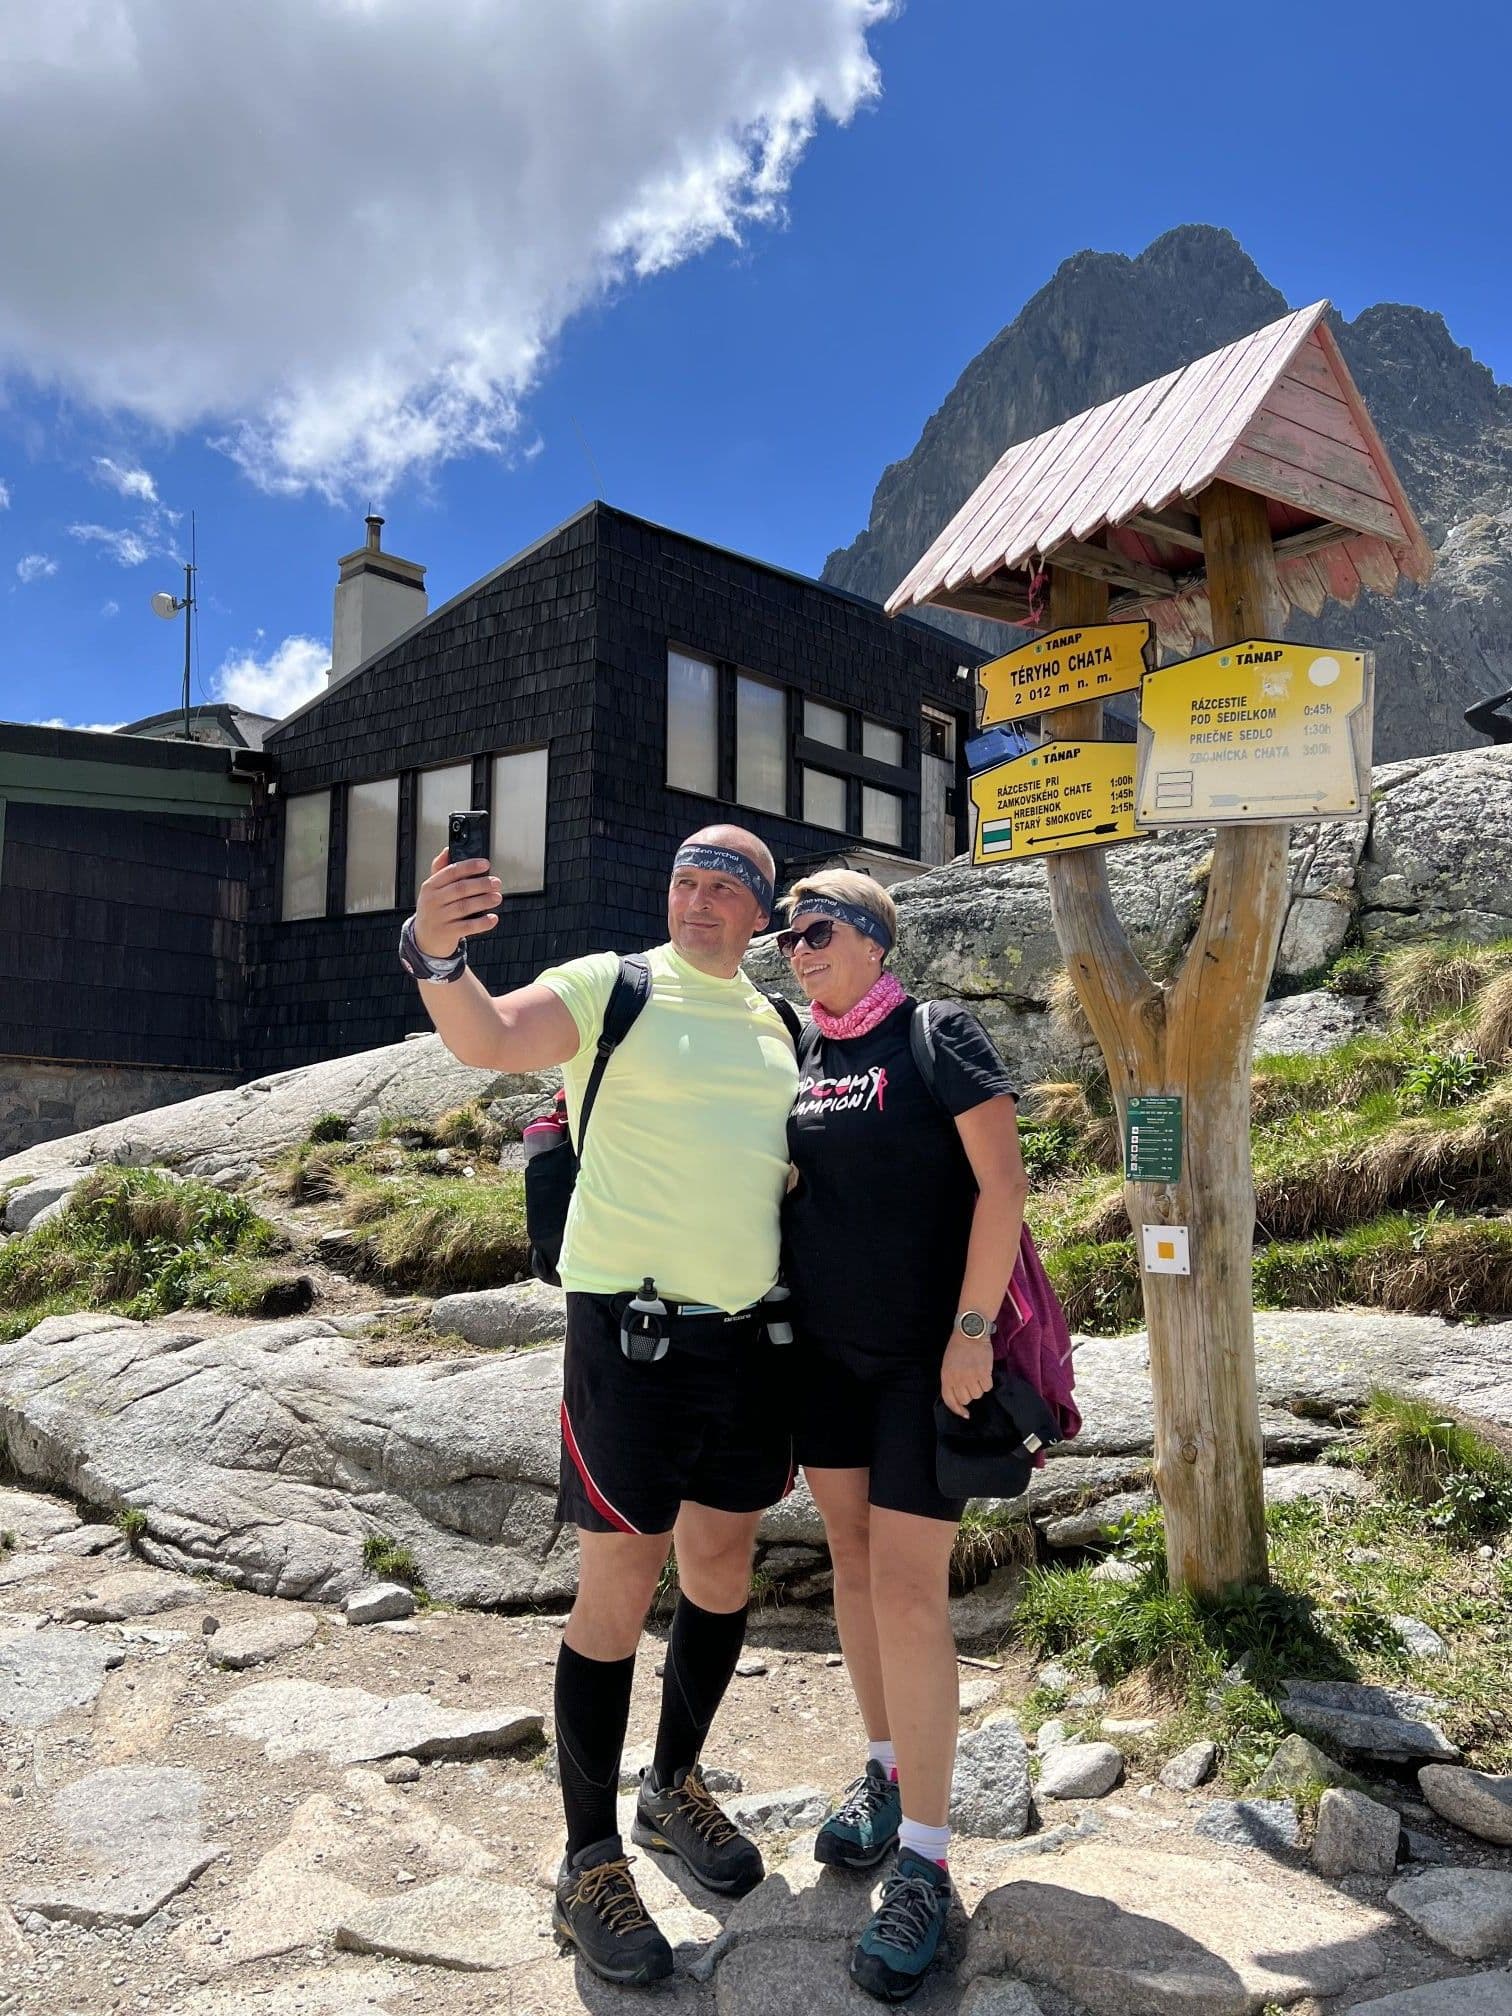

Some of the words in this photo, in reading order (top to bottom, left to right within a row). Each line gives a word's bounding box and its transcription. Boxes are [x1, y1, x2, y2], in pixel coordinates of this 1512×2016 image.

[1046, 633, 1082, 651] TANAP
[1010, 660, 1060, 687] TÉRYHO
[1068, 646, 1112, 672] CHATA
[1236, 650, 1283, 666] TANAP
[1015, 694, 1022, 704] 2
[1030, 686, 1050, 701] 012
[1058, 683, 1069, 694] m
[1078, 679, 1088, 688] n.
[1096, 672, 1112, 684] m.
[1192, 696, 1247, 711] RÁZCESTIE
[1190, 714, 1210, 725] POD
[1217, 708, 1276, 724] SEDIELKOM
[1304, 704, 1332, 716] 0:45h
[1190, 730, 1232, 744] PRIEČNE
[1240, 728, 1272, 741] SEDLO
[1304, 723, 1331, 736] 1:30h
[1043, 748, 1081, 764] TANAP
[1254, 746, 1290, 760] CHATA
[997, 779, 1040, 797] RÁZCESTIE
[1046, 776, 1059, 787] PRI
[997, 789, 1059, 810] ZAMKOVSKÉHO
[1064, 782, 1092, 797] CHATE
[1110, 775, 1133, 788] 1:00h
[1014, 801, 1062, 819] HREBIENOK
[1110, 788, 1134, 800] 1:45h
[1014, 817, 1040, 832] STARÝ
[1046, 809, 1092, 826] SMOKOVEC
[1110, 802, 1134, 814] 2:15h
